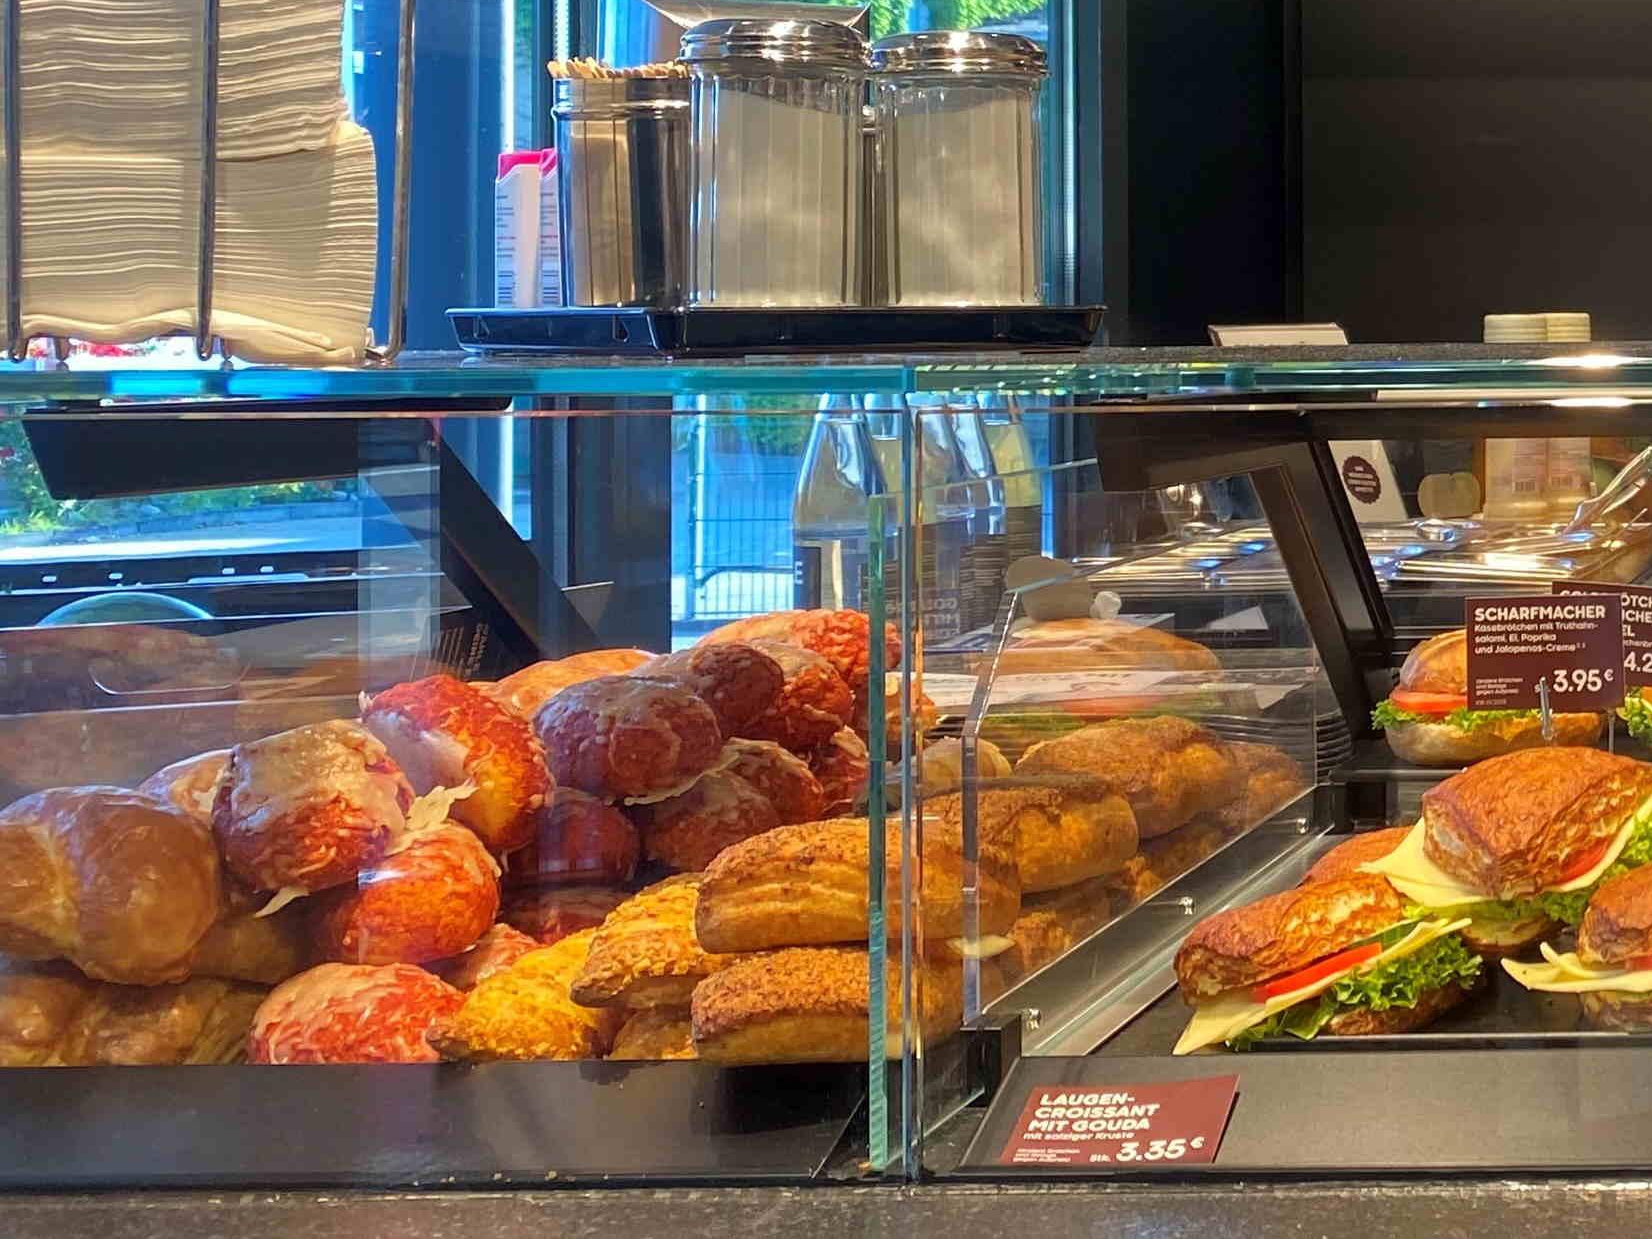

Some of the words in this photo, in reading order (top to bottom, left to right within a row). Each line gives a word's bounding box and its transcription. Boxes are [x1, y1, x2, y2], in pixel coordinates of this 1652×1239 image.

[1474, 605, 1606, 622] SCHARFMACHER
[1040, 1093, 1136, 1106] LAUGEN-
[1034, 1104, 1161, 1119] CROISSANT
[1028, 1120, 1069, 1132] MIT
[1071, 1118, 1151, 1132] GOUDA
[1045, 1132, 1093, 1142] salziger
[1095, 1131, 1135, 1140] Kruste
